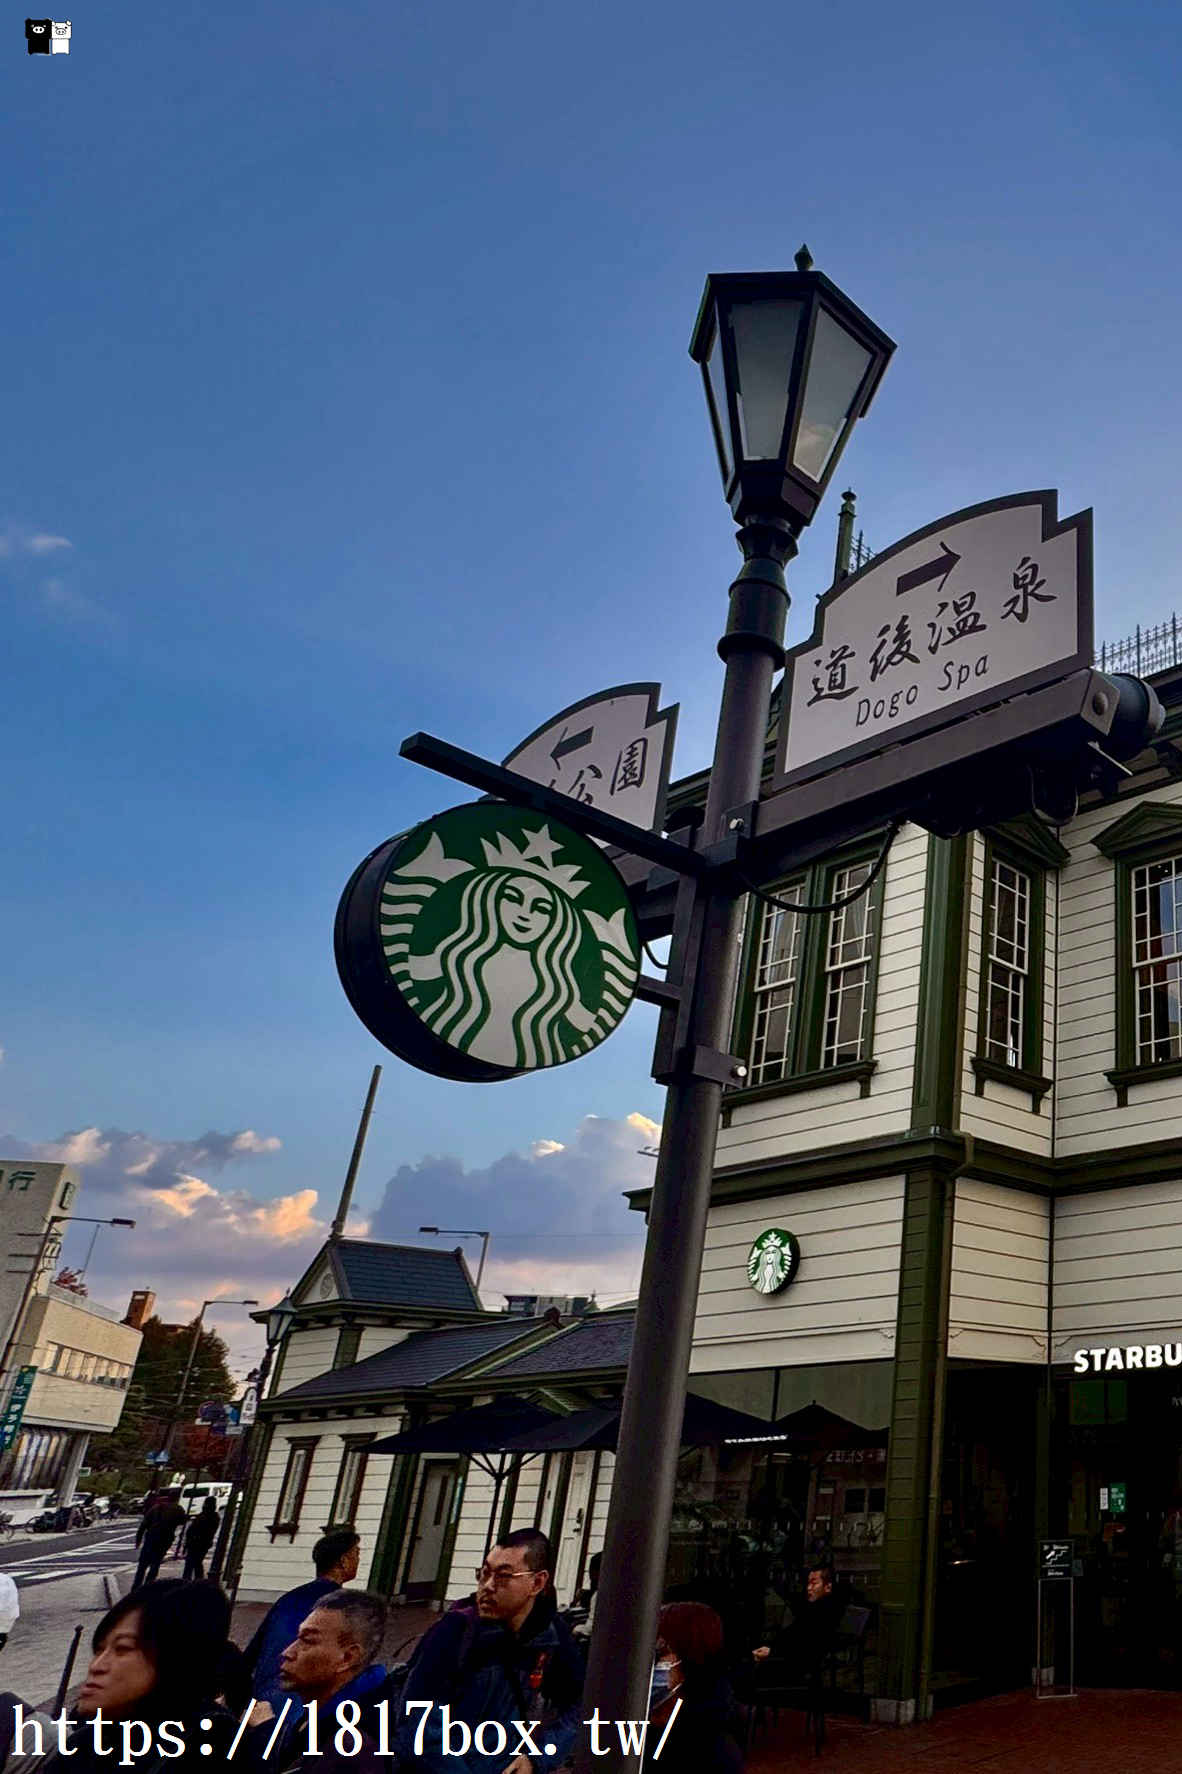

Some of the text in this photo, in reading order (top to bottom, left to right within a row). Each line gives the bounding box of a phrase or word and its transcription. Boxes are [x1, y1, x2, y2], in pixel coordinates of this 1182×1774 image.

[807, 556, 1057, 708] 道後温泉
[855, 652, 989, 727] Dogo Spa
